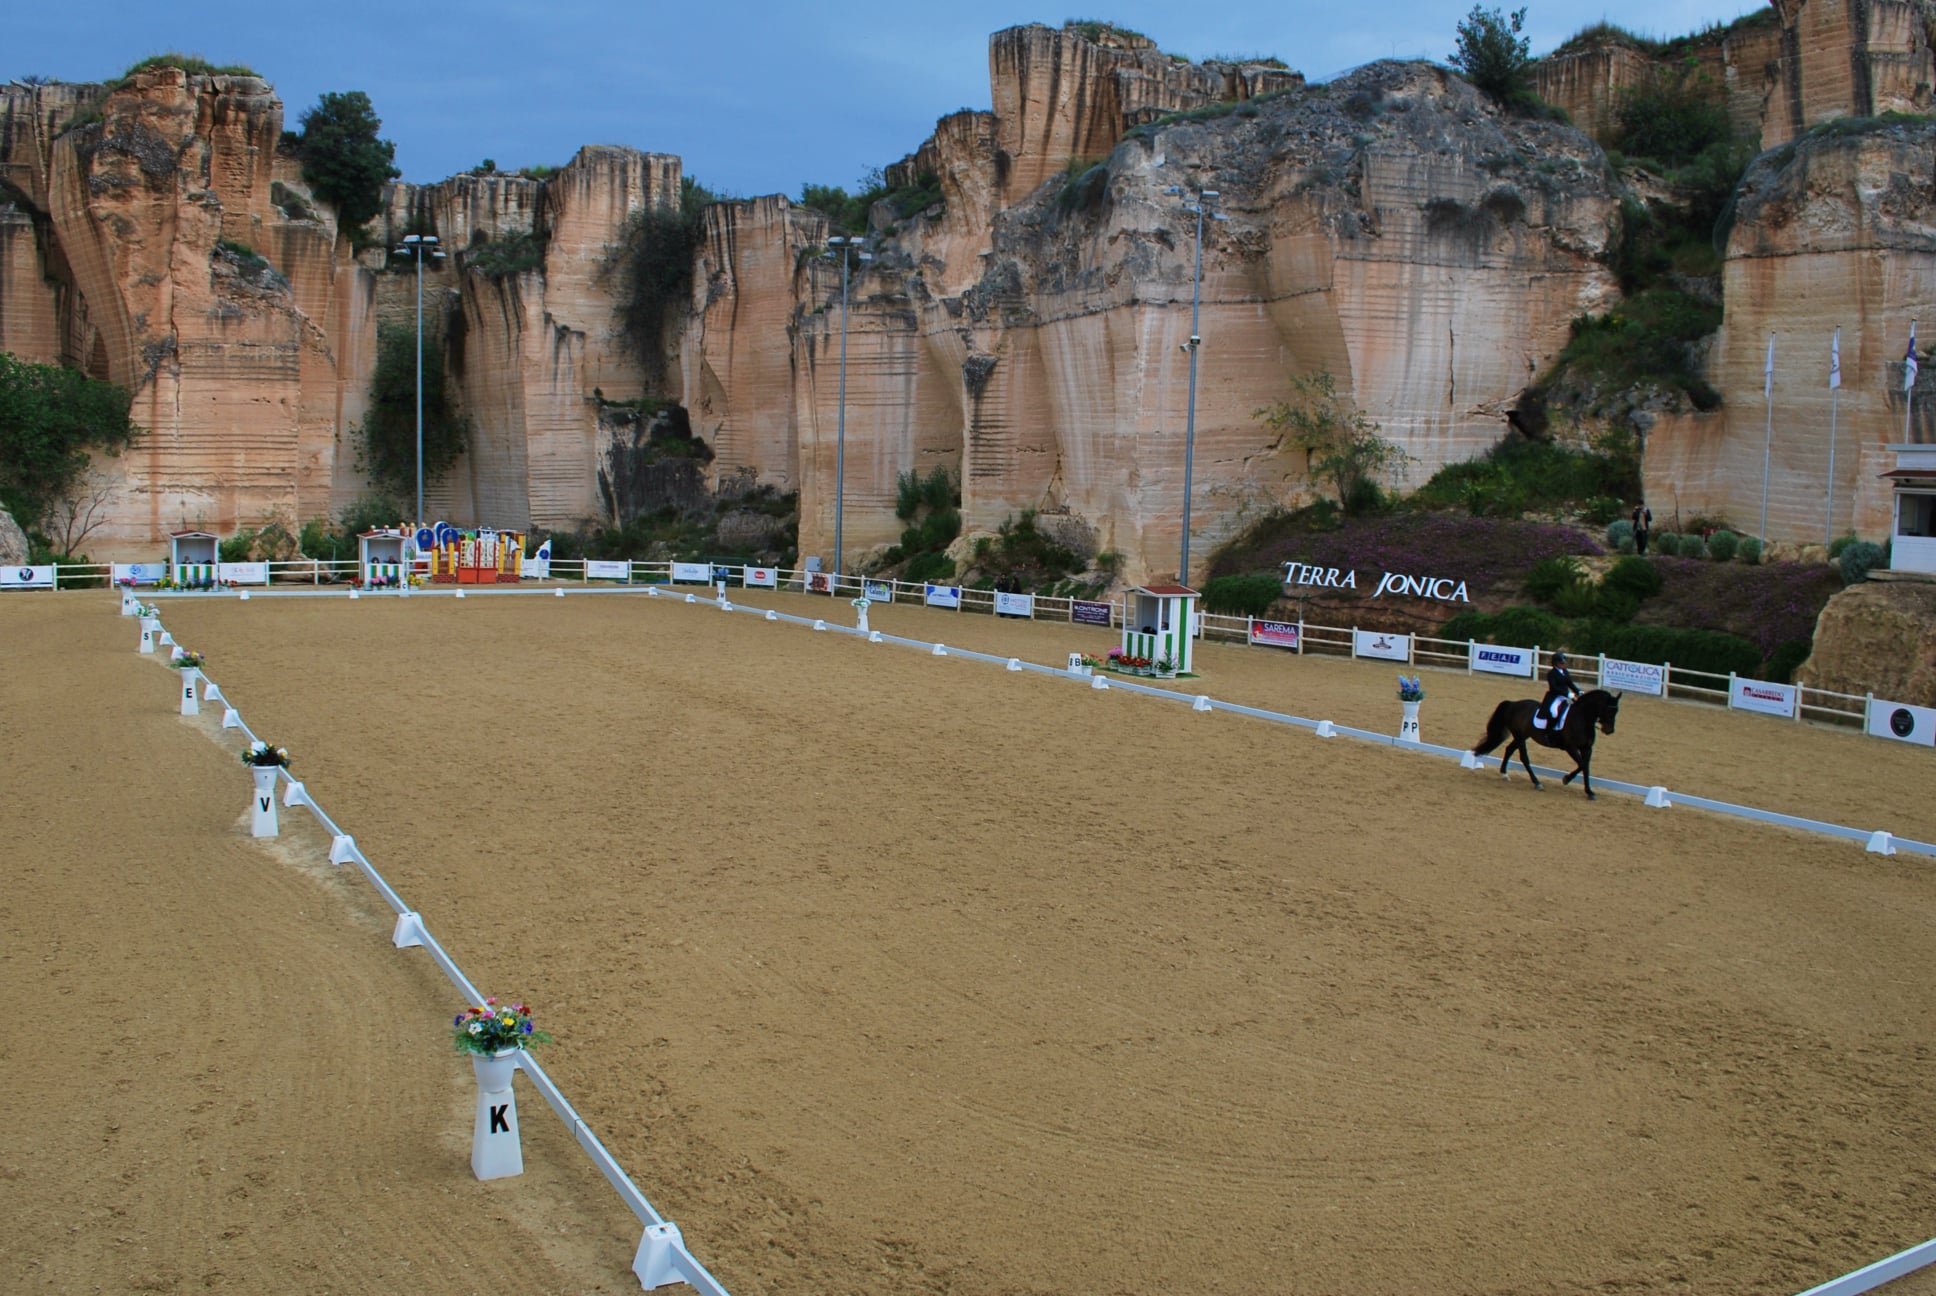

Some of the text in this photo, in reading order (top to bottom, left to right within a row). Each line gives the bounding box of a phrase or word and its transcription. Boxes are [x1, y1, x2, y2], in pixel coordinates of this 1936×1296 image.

[1283, 561, 1470, 602] TERRA JONICA
[143, 632, 149, 640] S
[1264, 623, 1296, 634] SAREMA
[1606, 661, 1660, 676] CATTOLICA
[186, 688, 193, 698] E
[260, 797, 271, 812] V
[490, 1104, 510, 1134] K
